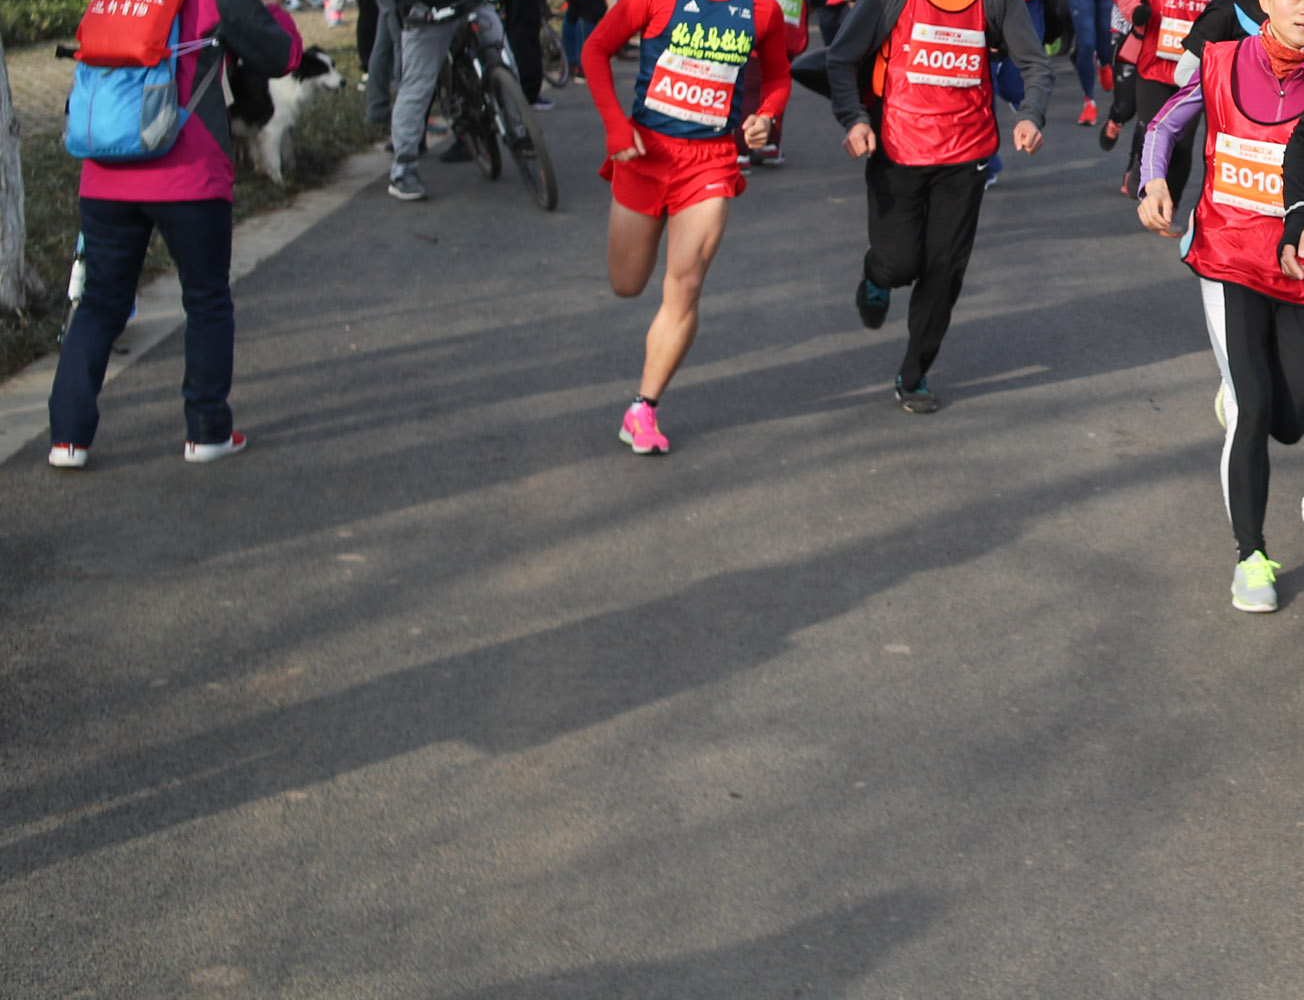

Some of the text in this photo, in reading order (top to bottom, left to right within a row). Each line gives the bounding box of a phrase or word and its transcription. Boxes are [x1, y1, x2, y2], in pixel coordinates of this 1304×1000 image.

[669, 43, 705, 60] beijing
[912, 48, 982, 72] A0043
[654, 75, 728, 109] A0082
[1220, 161, 1285, 195] B010
